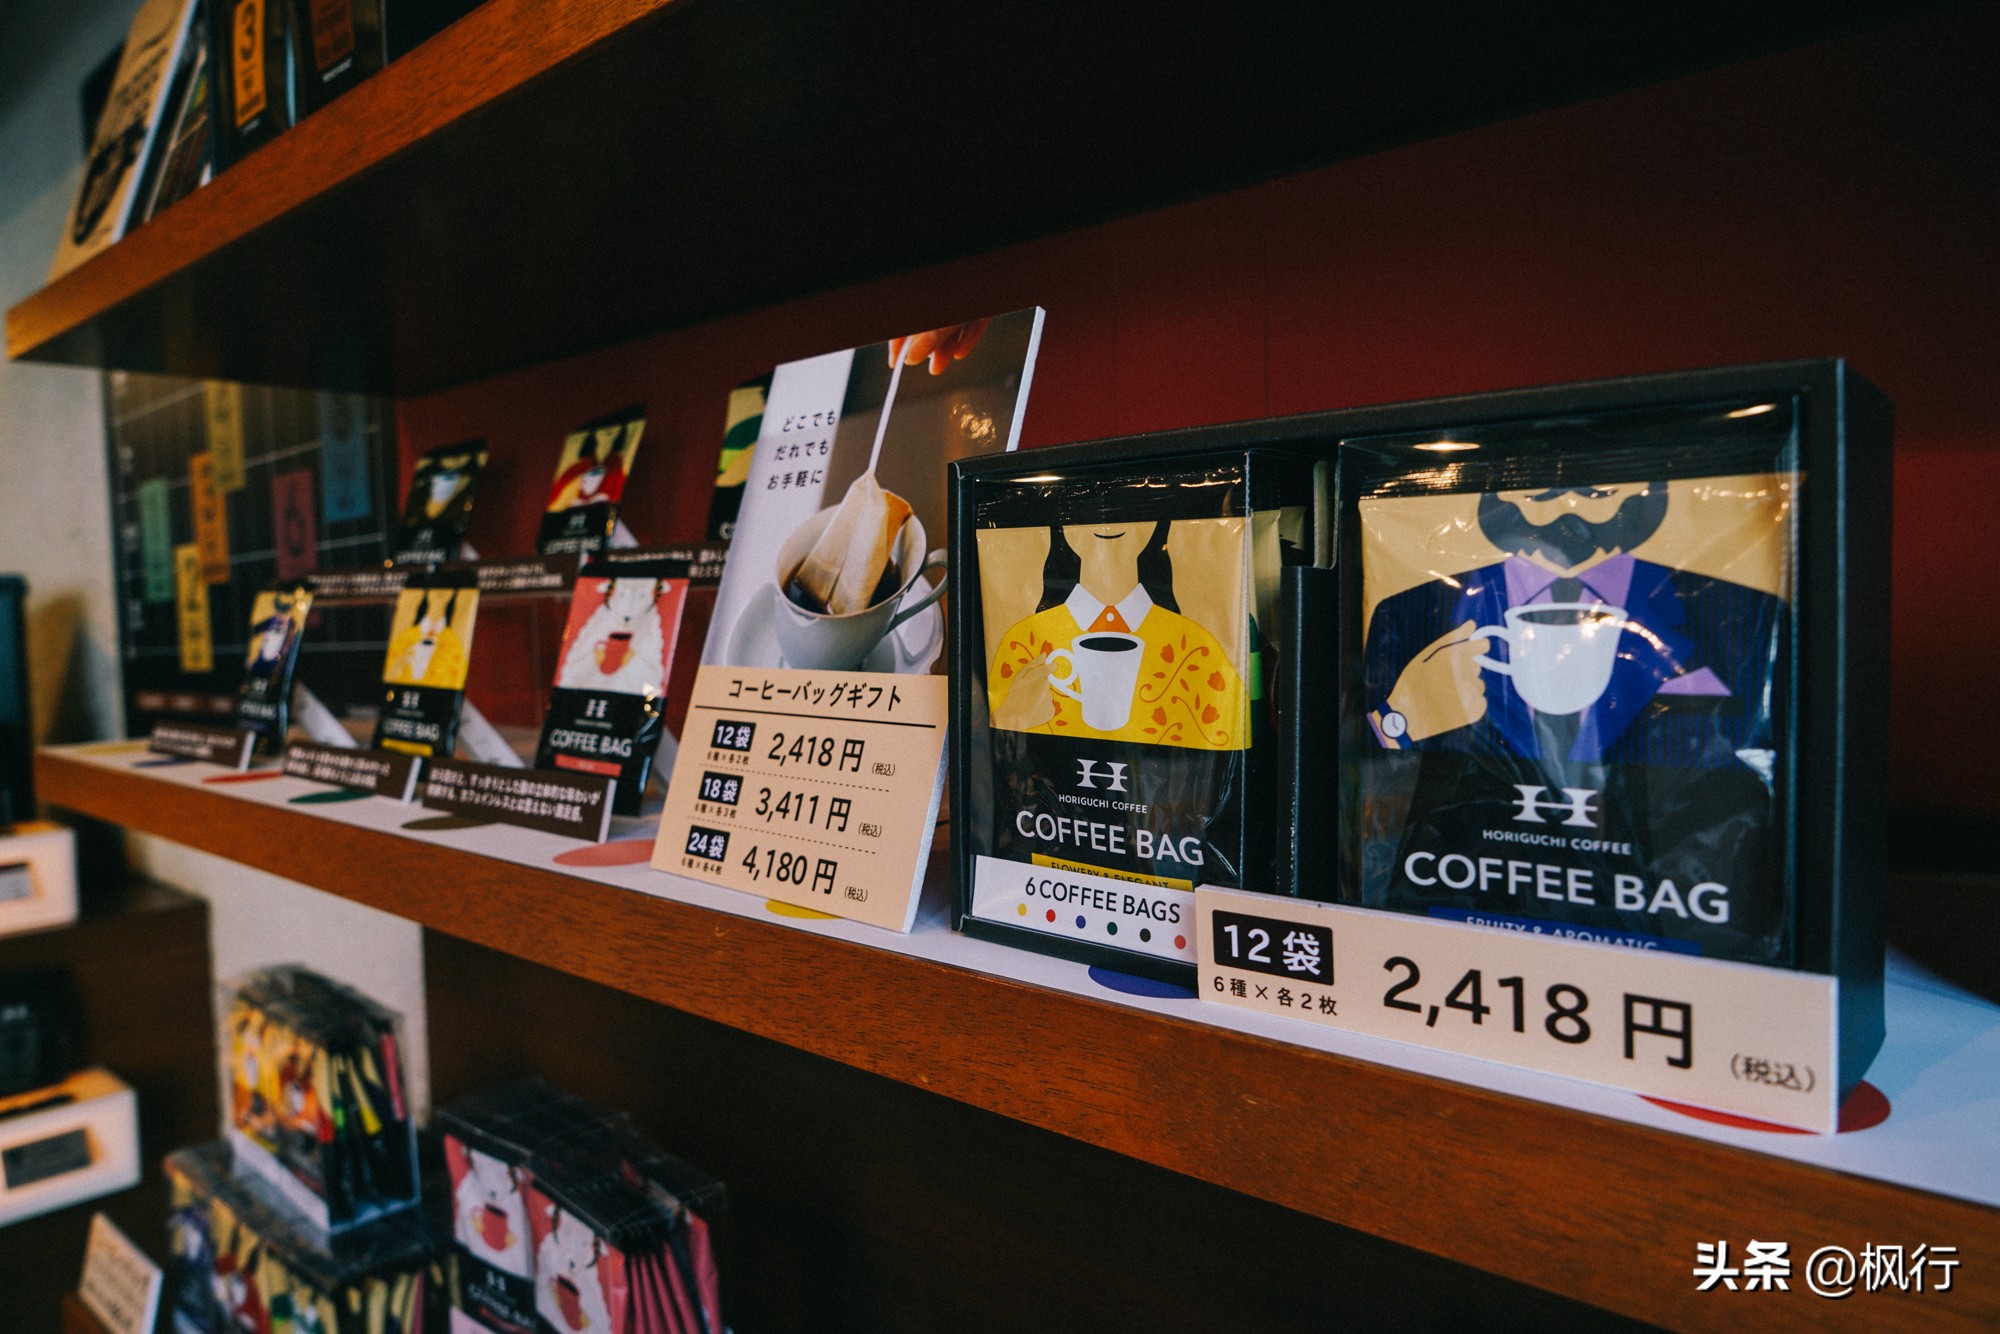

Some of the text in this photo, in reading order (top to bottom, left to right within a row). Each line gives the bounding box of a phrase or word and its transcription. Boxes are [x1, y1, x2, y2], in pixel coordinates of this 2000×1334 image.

[782, 409, 836, 432] どこでも
[774, 438, 829, 461] だれでも
[766, 470, 823, 490] お手軽に
[729, 679, 901, 711] コーヒーバッグギフト
[549, 728, 633, 758] COFFEE BAG
[871, 761, 896, 777] (税込)
[1058, 793, 1148, 814] HORIGUCHI COFFEE
[858, 821, 882, 838] (税込)
[1015, 810, 1204, 866] COFFEE BAG
[1482, 829, 1632, 856] HORIGUCHI COFFEE
[843, 885, 868, 903] (税込)
[1404, 851, 1730, 924] COFFEE BAG
[1039, 879, 1117, 912] COFFEE
[1122, 893, 1181, 924] BAGS
[1730, 1052, 1815, 1093] (税込)
